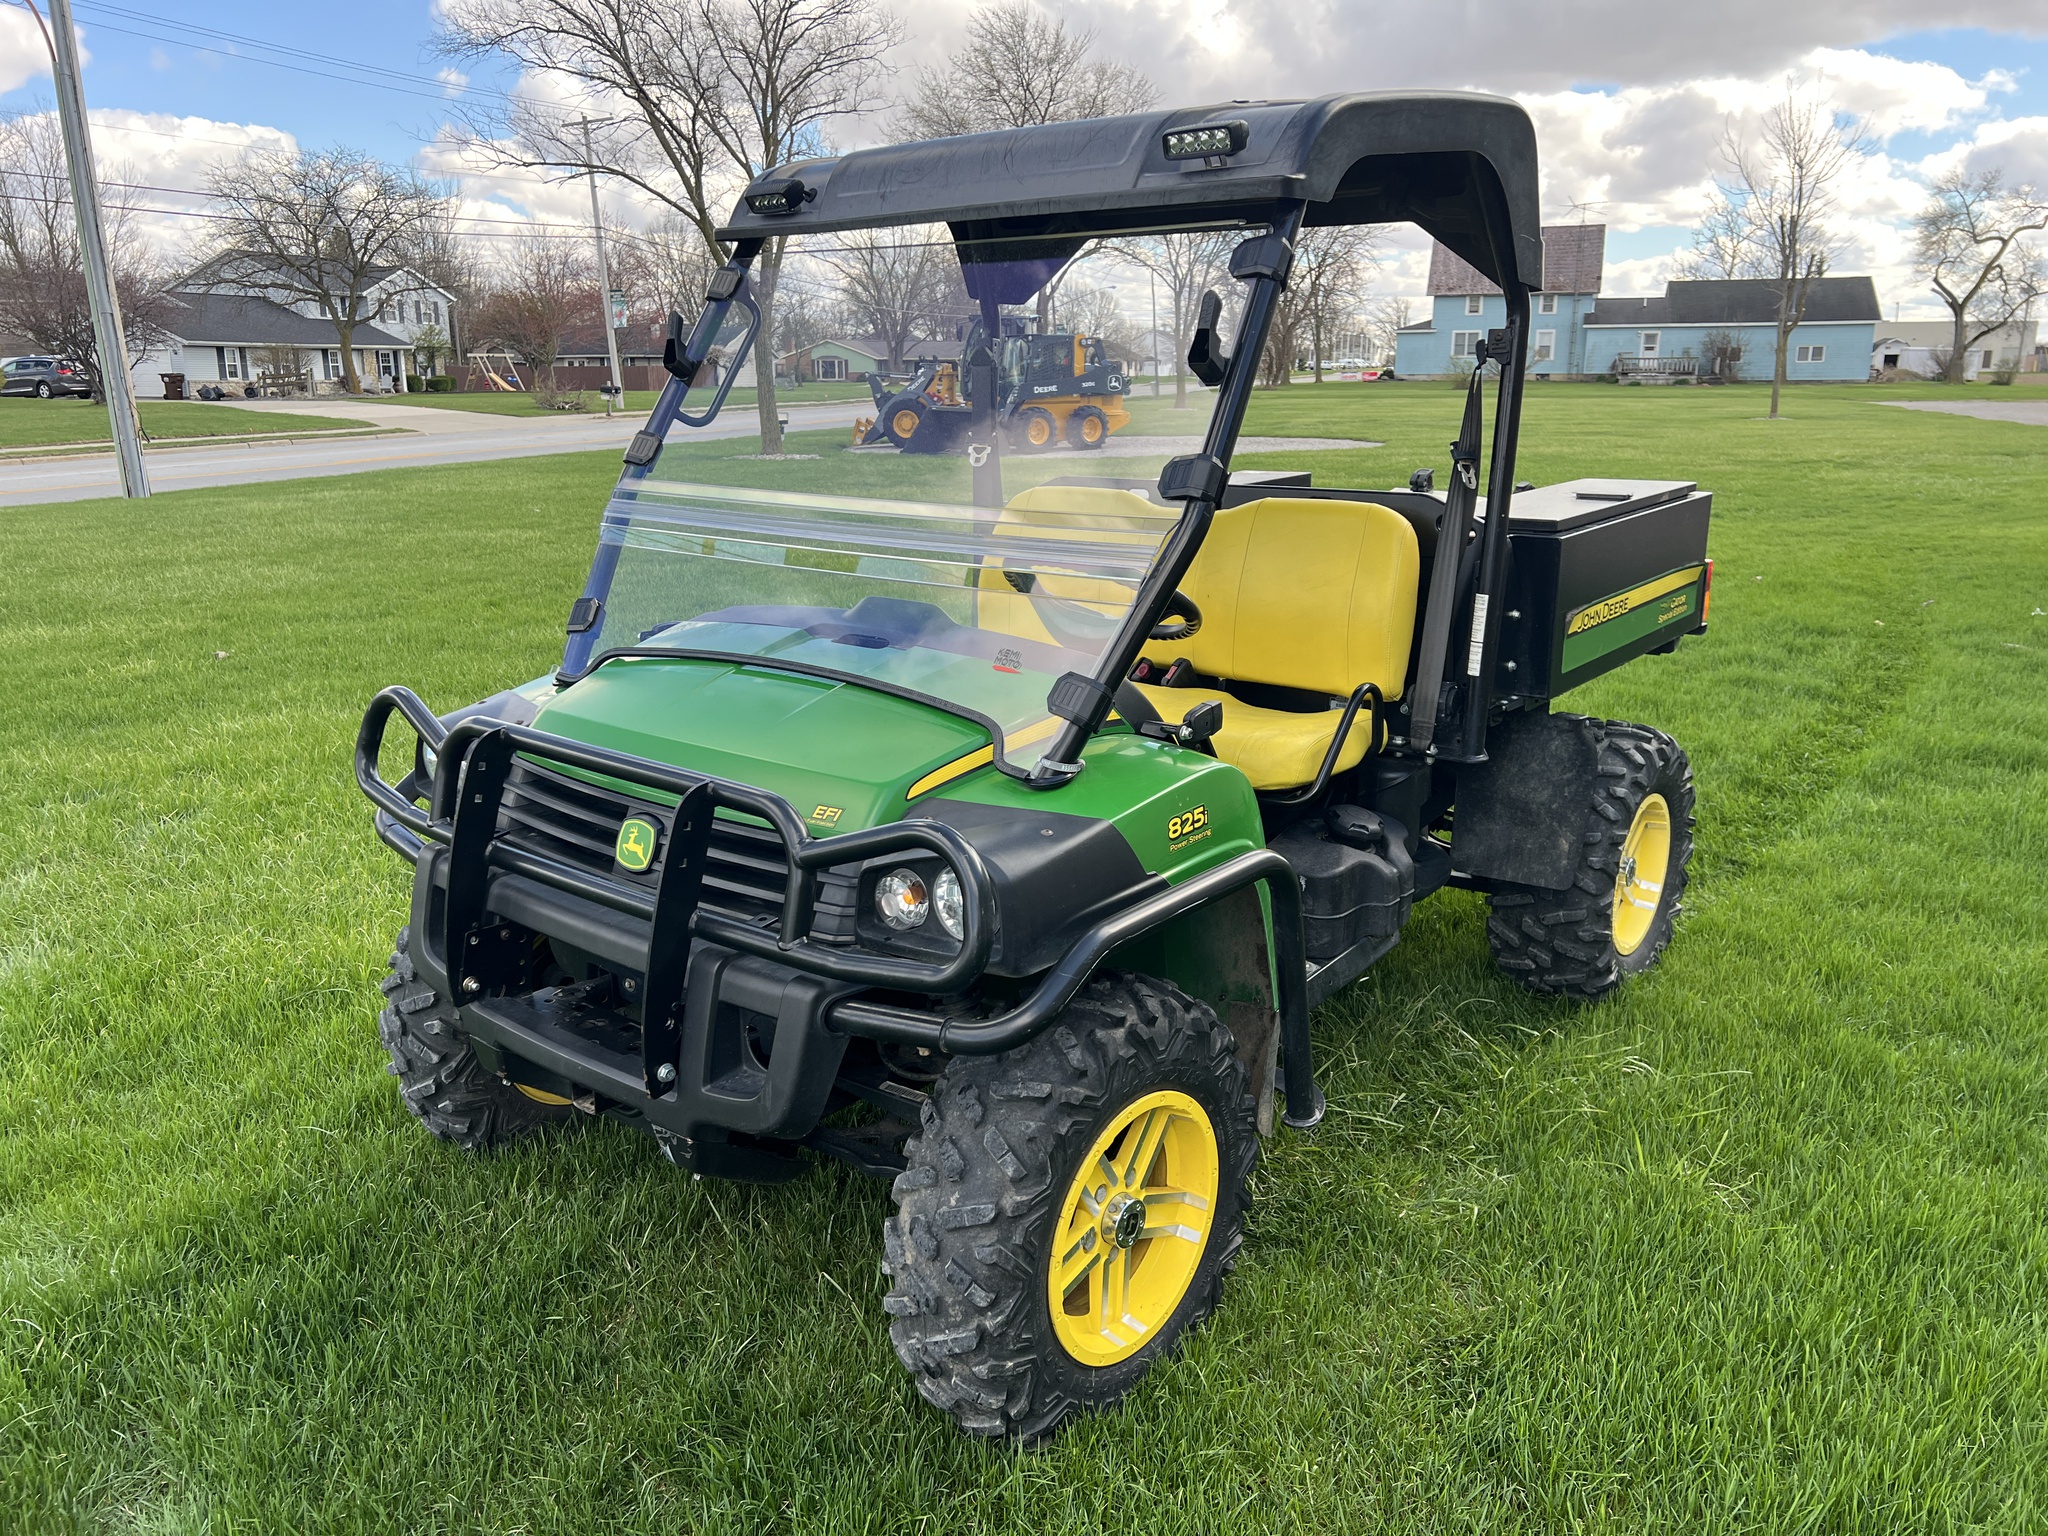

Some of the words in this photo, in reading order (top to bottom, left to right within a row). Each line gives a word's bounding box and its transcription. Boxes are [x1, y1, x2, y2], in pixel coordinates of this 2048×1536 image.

[1033, 385, 1058, 393] DEERE
[1577, 607, 1602, 631] JOHN
[1602, 597, 1629, 620] DEERE
[1657, 611, 1674, 624] Special
[1672, 604, 1688, 617] Edition
[993, 655, 1023, 670] MOTO
[997, 648, 1023, 660] KEMI
[812, 805, 843, 822] EFI
[1168, 805, 1208, 840] 825i
[1169, 839, 1189, 853] Power
[1188, 828, 1213, 844] Steering
